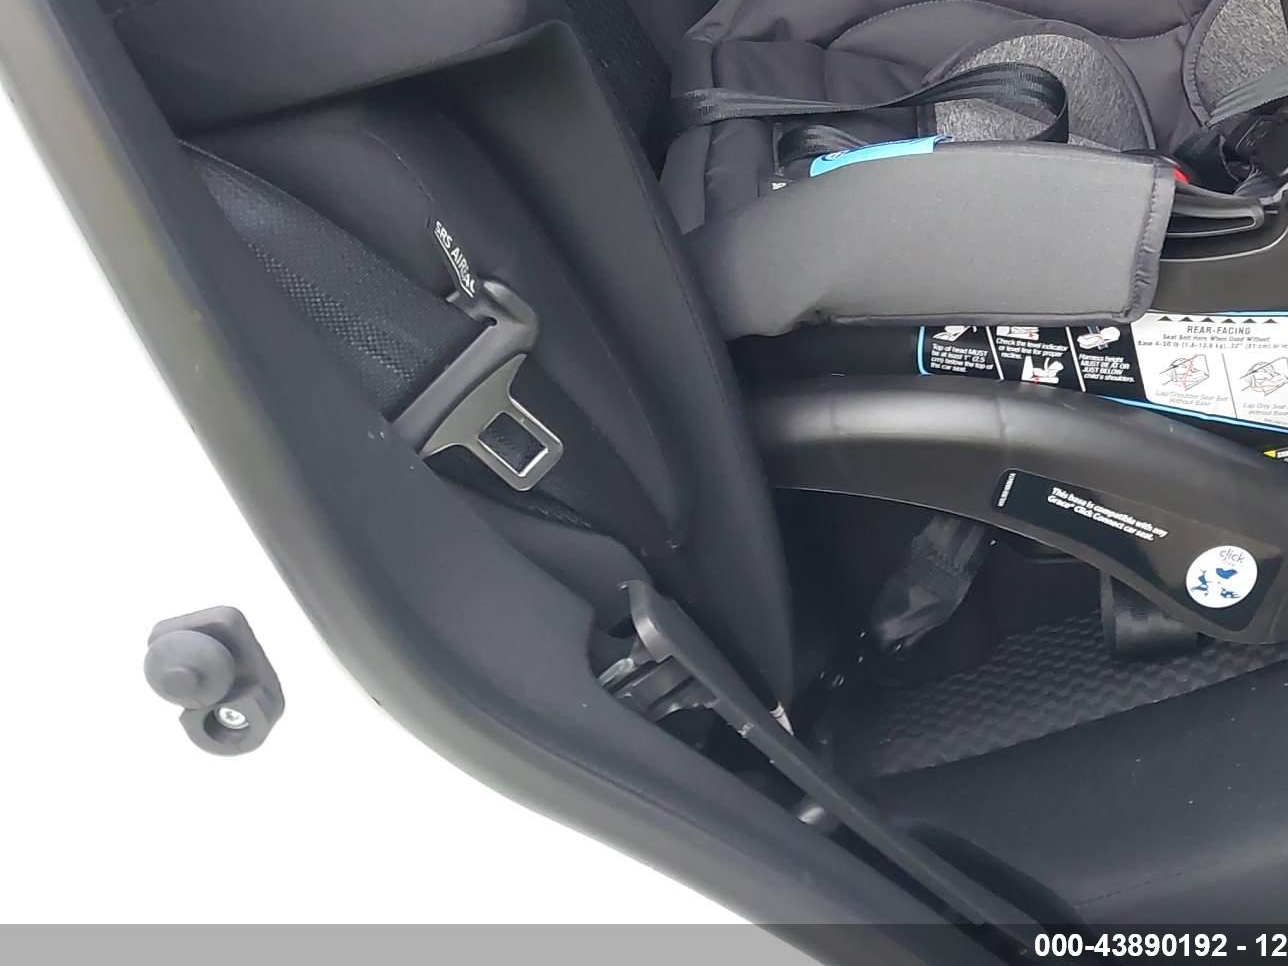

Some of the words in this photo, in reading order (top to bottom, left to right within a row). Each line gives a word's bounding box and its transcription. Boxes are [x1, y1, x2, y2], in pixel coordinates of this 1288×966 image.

[435, 221, 453, 248] SRS
[1187, 326, 1252, 334] REAR-FACING
[996, 338, 1016, 346] Check
[1042, 343, 1068, 352] indicator
[968, 349, 988, 357] MUST
[1042, 350, 1064, 358] proper
[1051, 487, 1069, 500] This
[1067, 493, 1088, 508] base
[1086, 501, 1095, 511] is
[1093, 503, 1136, 527] compatible
[1135, 520, 1153, 533] with
[1151, 526, 1168, 539] any
[1073, 505, 1094, 519] Click
[1092, 512, 1125, 531] Connect
[1123, 524, 1137, 535] car
[1135, 528, 1155, 542] seat.
